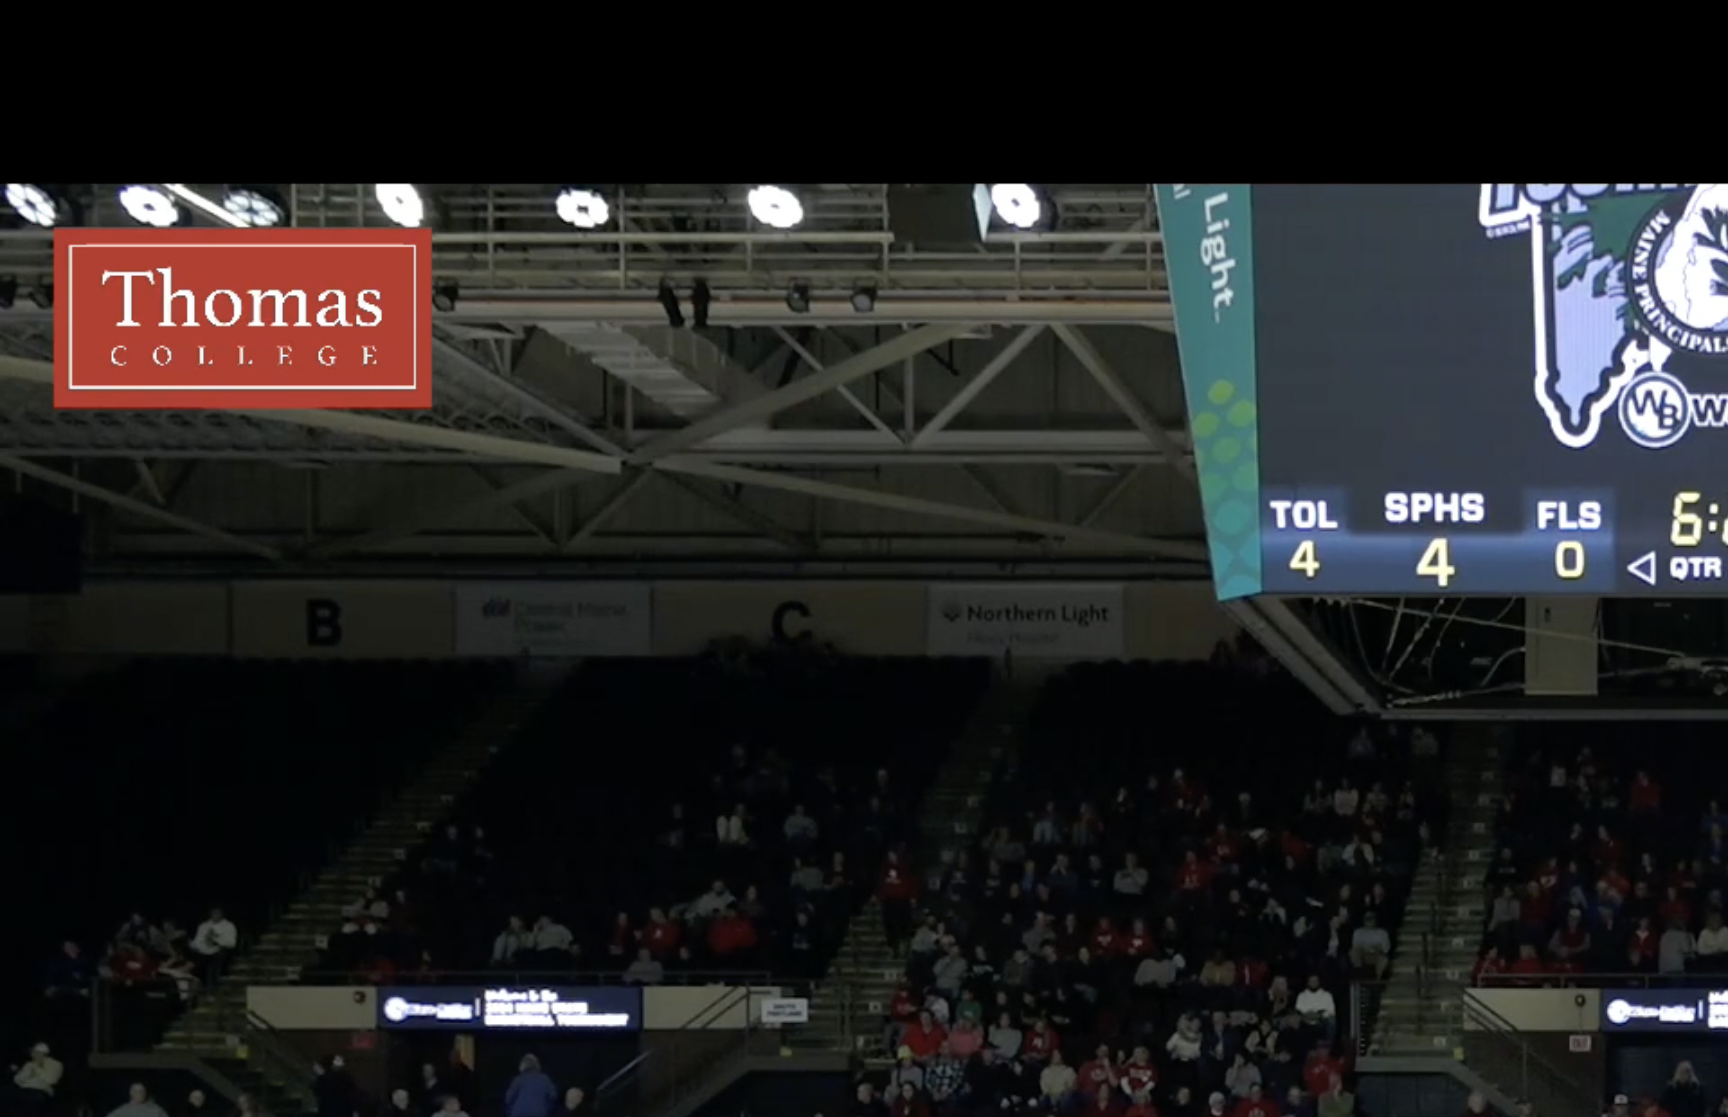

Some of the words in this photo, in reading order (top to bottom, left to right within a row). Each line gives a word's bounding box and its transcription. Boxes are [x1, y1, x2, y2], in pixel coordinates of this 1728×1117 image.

[1200, 192, 1236, 308] Light
[1632, 209, 1671, 280] MAINE
[1270, 501, 1338, 530] TOL
[1384, 493, 1485, 523] SPHS
[1537, 502, 1602, 530] FLS
[1289, 540, 1320, 577] 4
[1416, 538, 1455, 587] 4
[1554, 540, 1585, 577] 0
[1670, 556, 1722, 579] QTR
[306, 599, 342, 646] B
[772, 601, 813, 645] C
[967, 604, 1056, 622] Northern
[1061, 604, 1109, 627] Light
